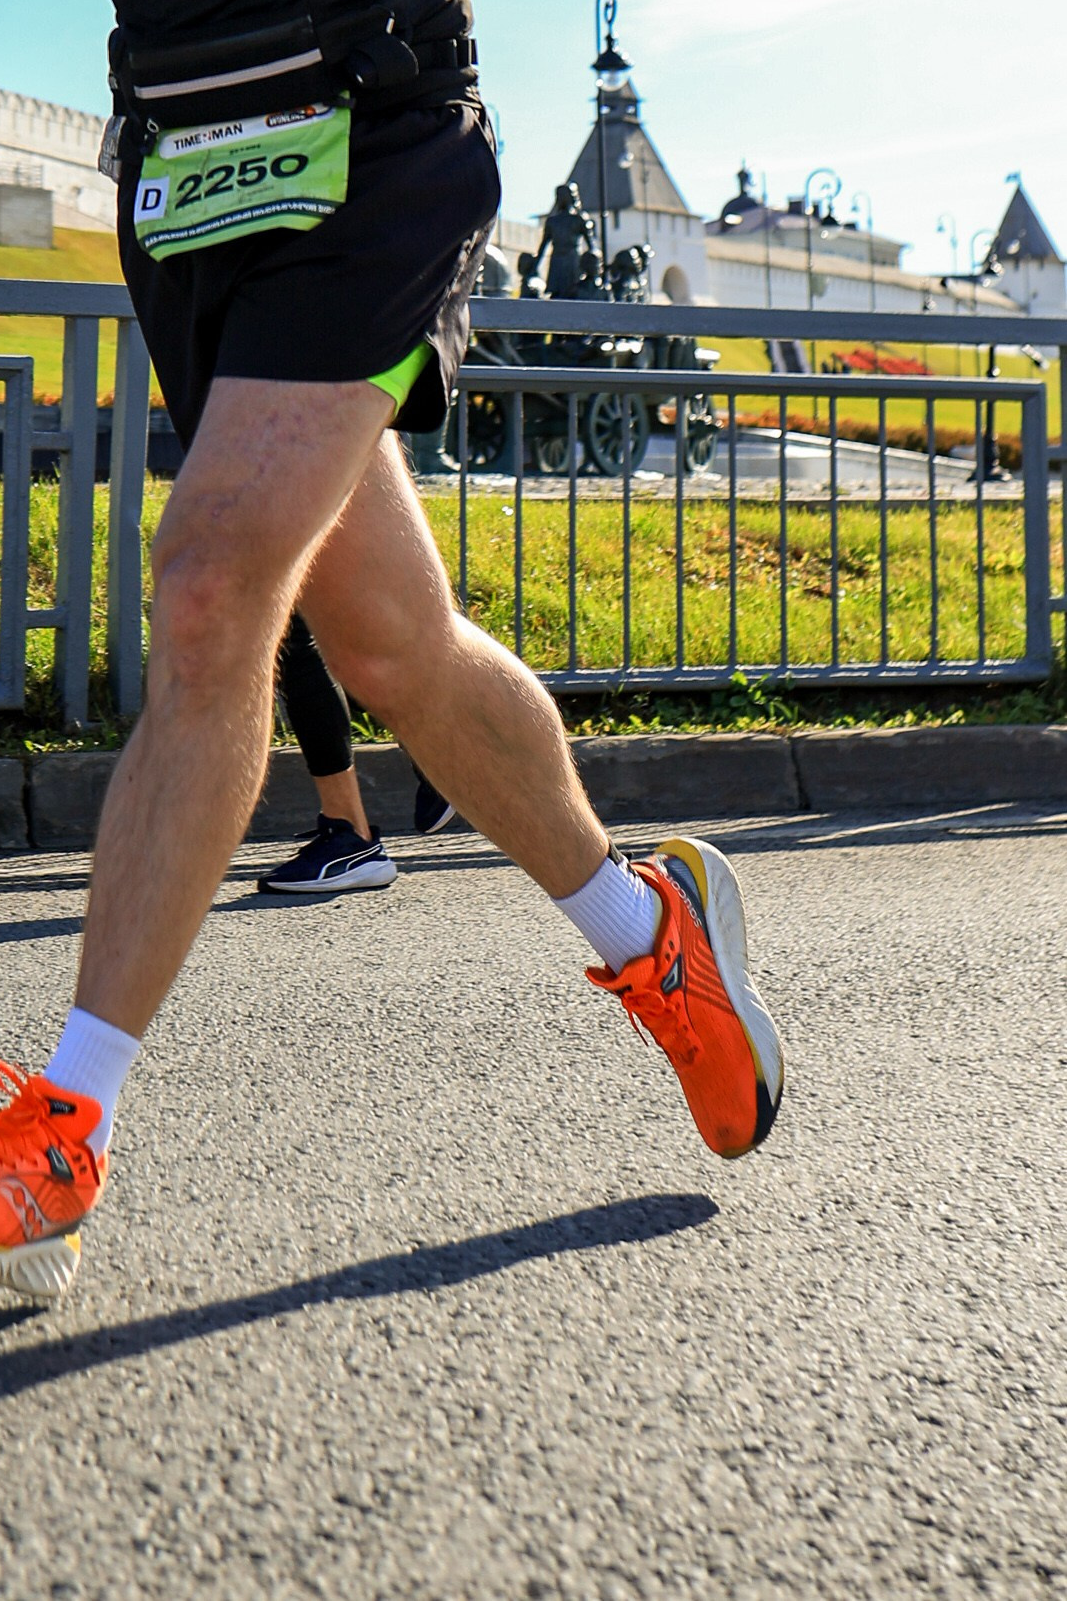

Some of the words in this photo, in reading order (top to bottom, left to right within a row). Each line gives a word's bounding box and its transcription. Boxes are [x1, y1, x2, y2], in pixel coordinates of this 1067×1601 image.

[141, 188, 162, 211] D
[175, 153, 309, 211] 2250
[662, 871, 702, 928] saucon
